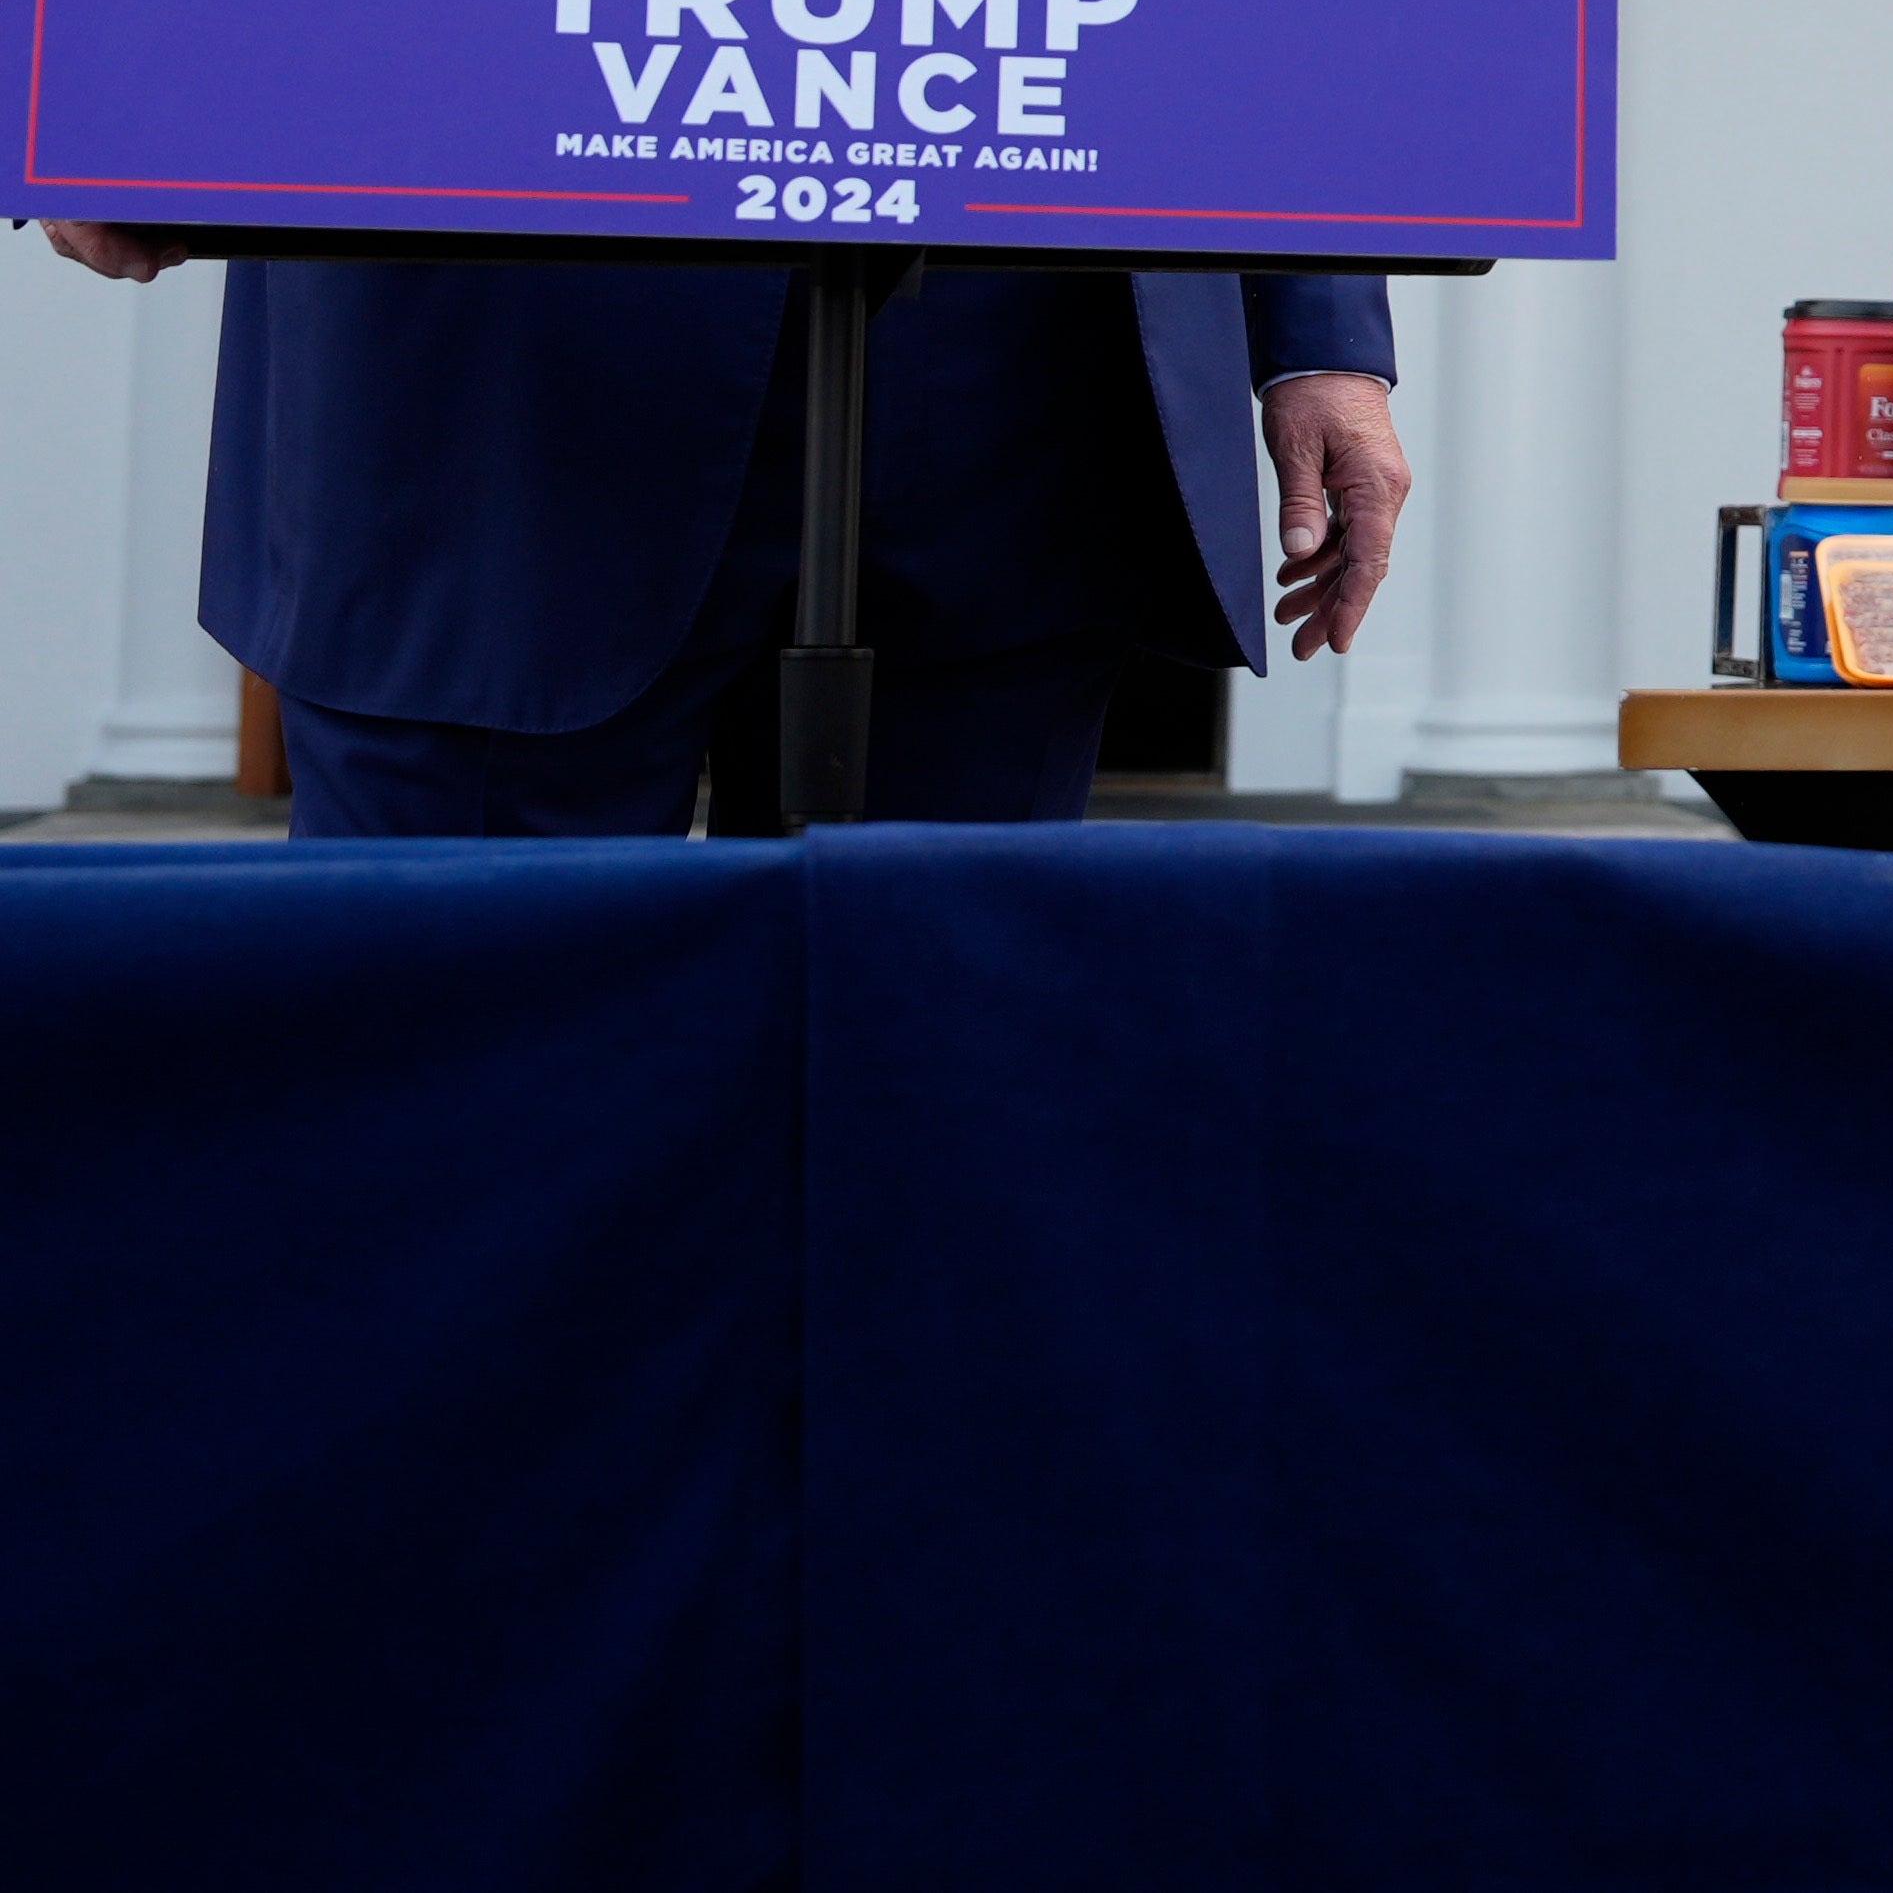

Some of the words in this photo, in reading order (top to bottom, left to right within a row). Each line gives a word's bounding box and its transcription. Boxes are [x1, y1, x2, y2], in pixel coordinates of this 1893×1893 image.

[592, 42, 1067, 136] VANCE
[556, 132, 658, 158] MAKE
[669, 136, 834, 164] AMERICA
[846, 142, 963, 168] GREAT
[974, 146, 1098, 172] AGAIN!
[735, 174, 920, 224] 2024
